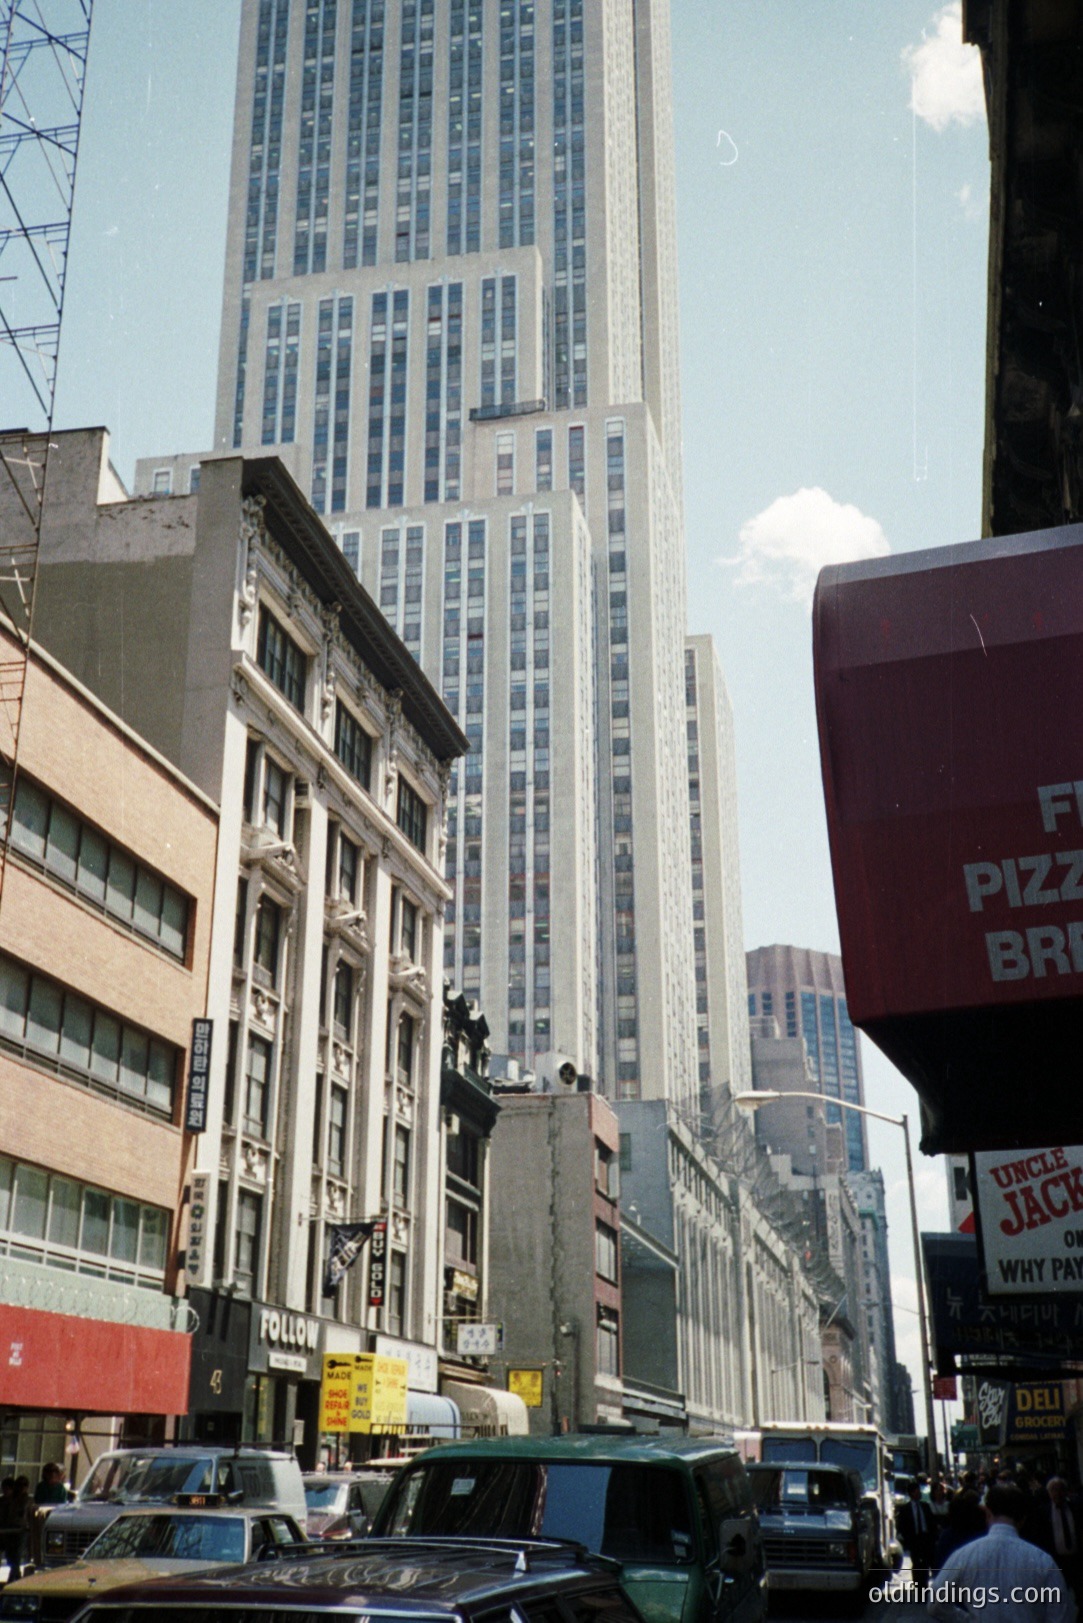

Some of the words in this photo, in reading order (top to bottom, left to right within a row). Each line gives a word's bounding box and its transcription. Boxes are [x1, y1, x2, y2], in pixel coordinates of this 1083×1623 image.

[989, 1147, 1069, 1189] UNCLE
[371, 1231, 385, 1257] BUY
[998, 1258, 1046, 1284] WHY
[370, 1263, 383, 1298] GOLD
[260, 1308, 320, 1350] FOLLOW
[327, 1371, 352, 1380] MADE
[328, 1389, 347, 1398] SHOE
[356, 1384, 368, 1393] WE
[355, 1397, 368, 1406] BUY
[1015, 1387, 1061, 1411] DELI
[325, 1401, 350, 1410] REPAIR
[351, 1409, 371, 1420] GOLD
[326, 1417, 348, 1427] SHINE
[1015, 1415, 1067, 1428] GROCERY
